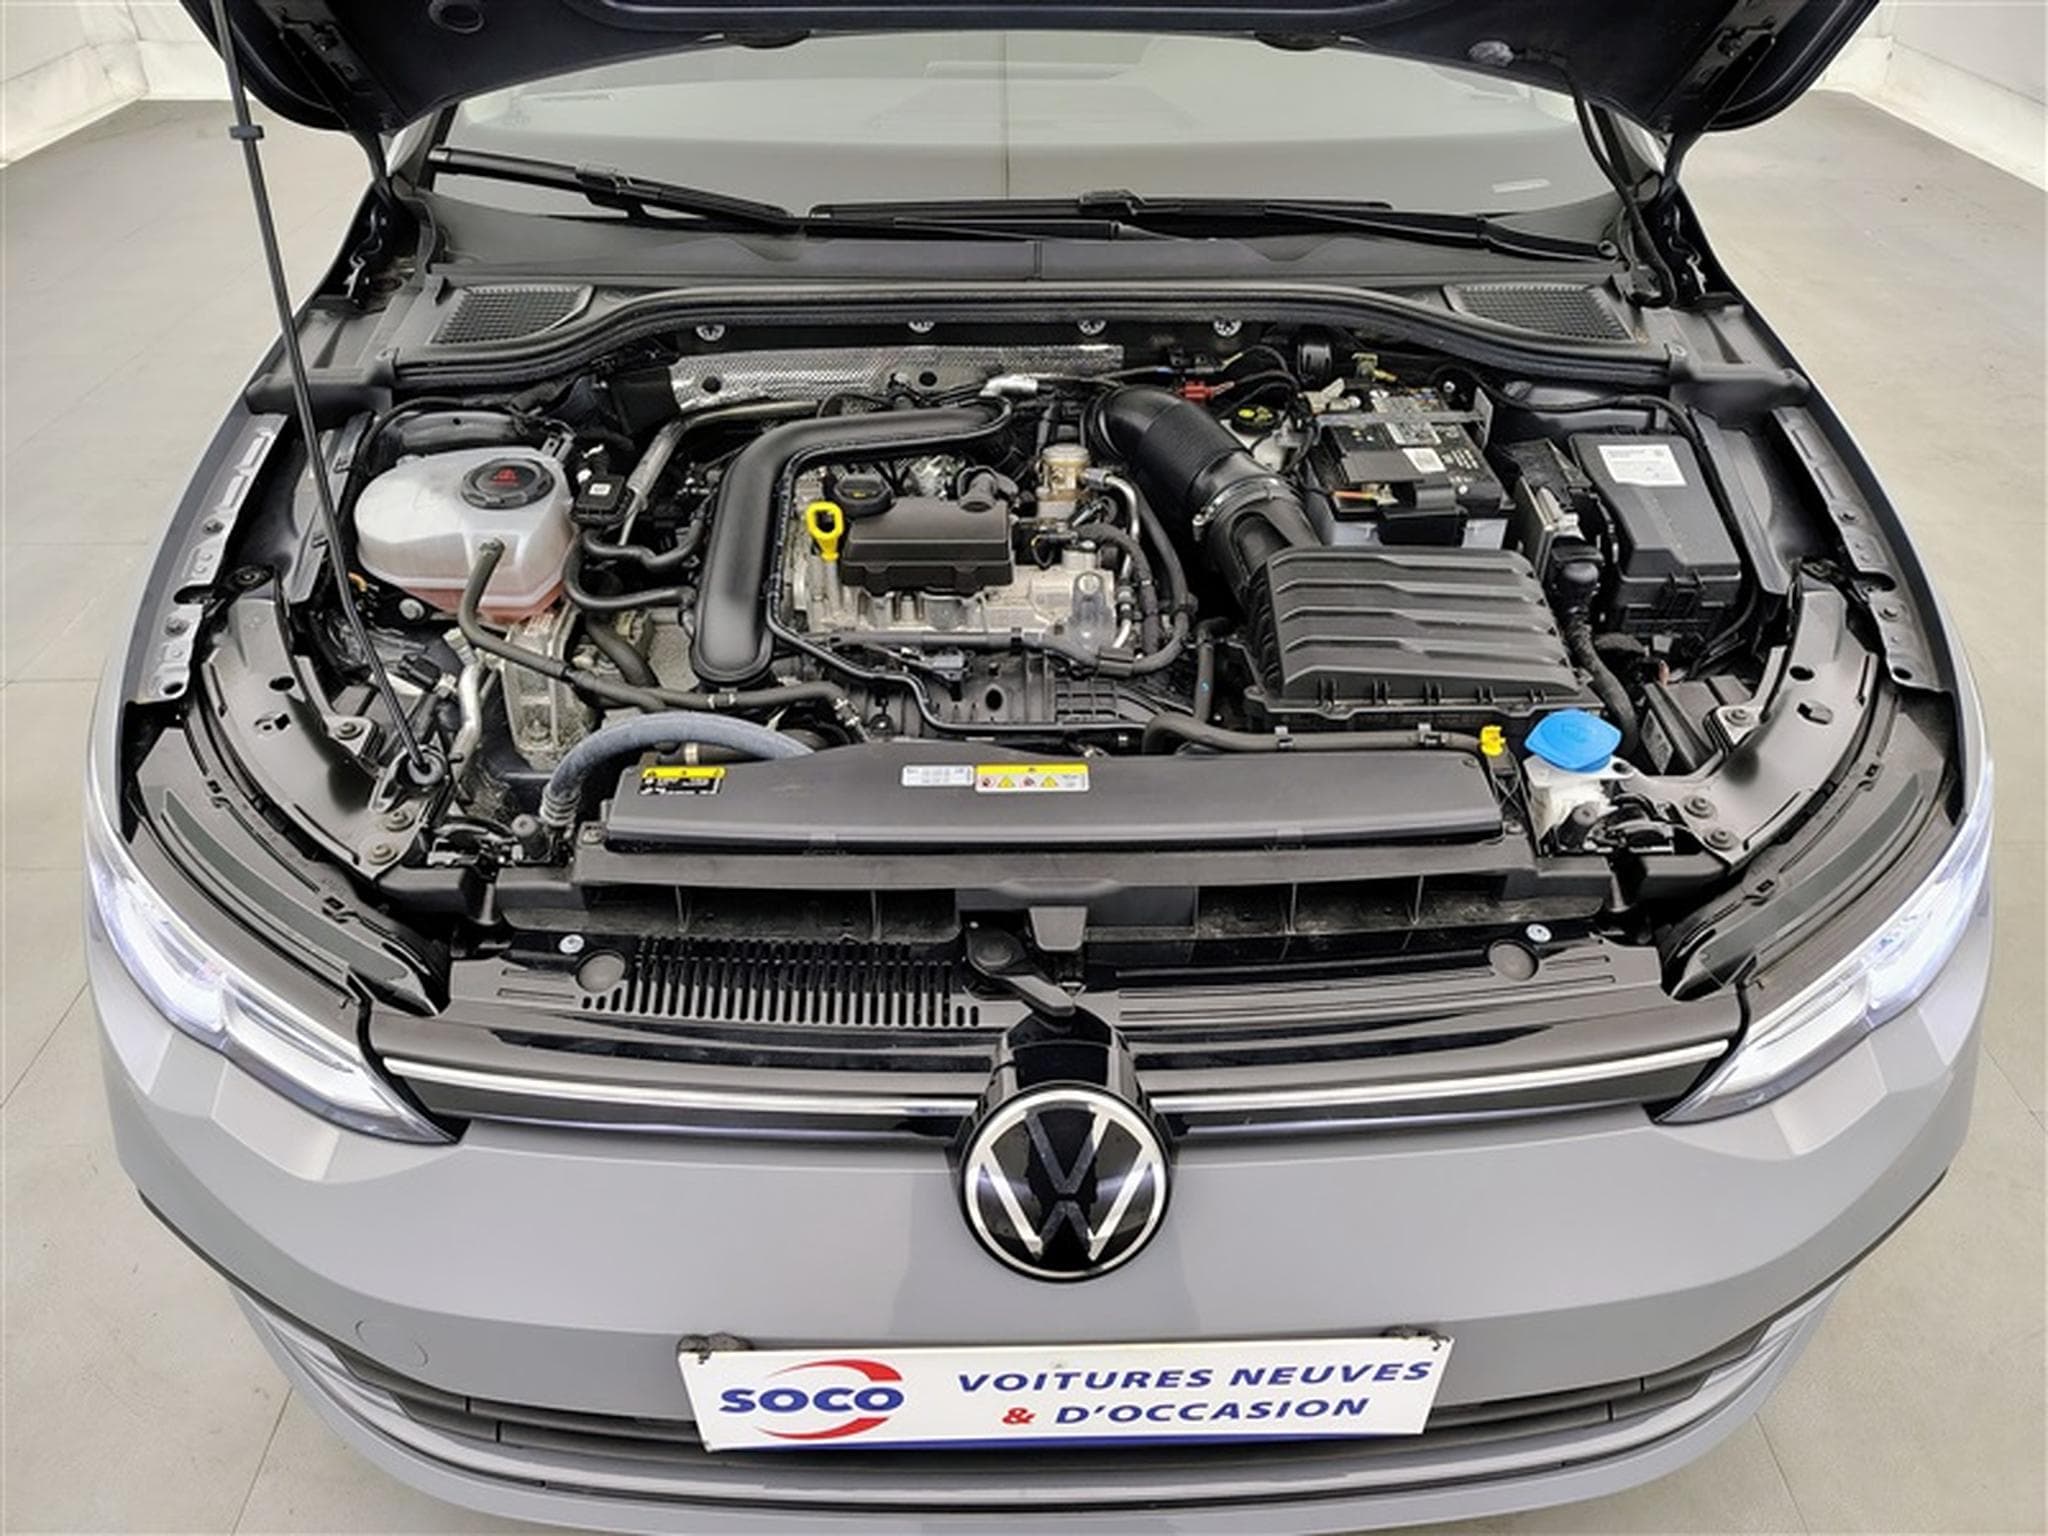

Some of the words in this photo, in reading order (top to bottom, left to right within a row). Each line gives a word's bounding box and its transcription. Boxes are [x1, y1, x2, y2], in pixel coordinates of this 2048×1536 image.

[958, 1370, 1213, 1391] VOITURES
[1230, 1362, 1432, 1386] NEUVES
[719, 1387, 905, 1414] SOCO
[1002, 1407, 1036, 1425] &
[1055, 1398, 1369, 1424] D'OCCASION
